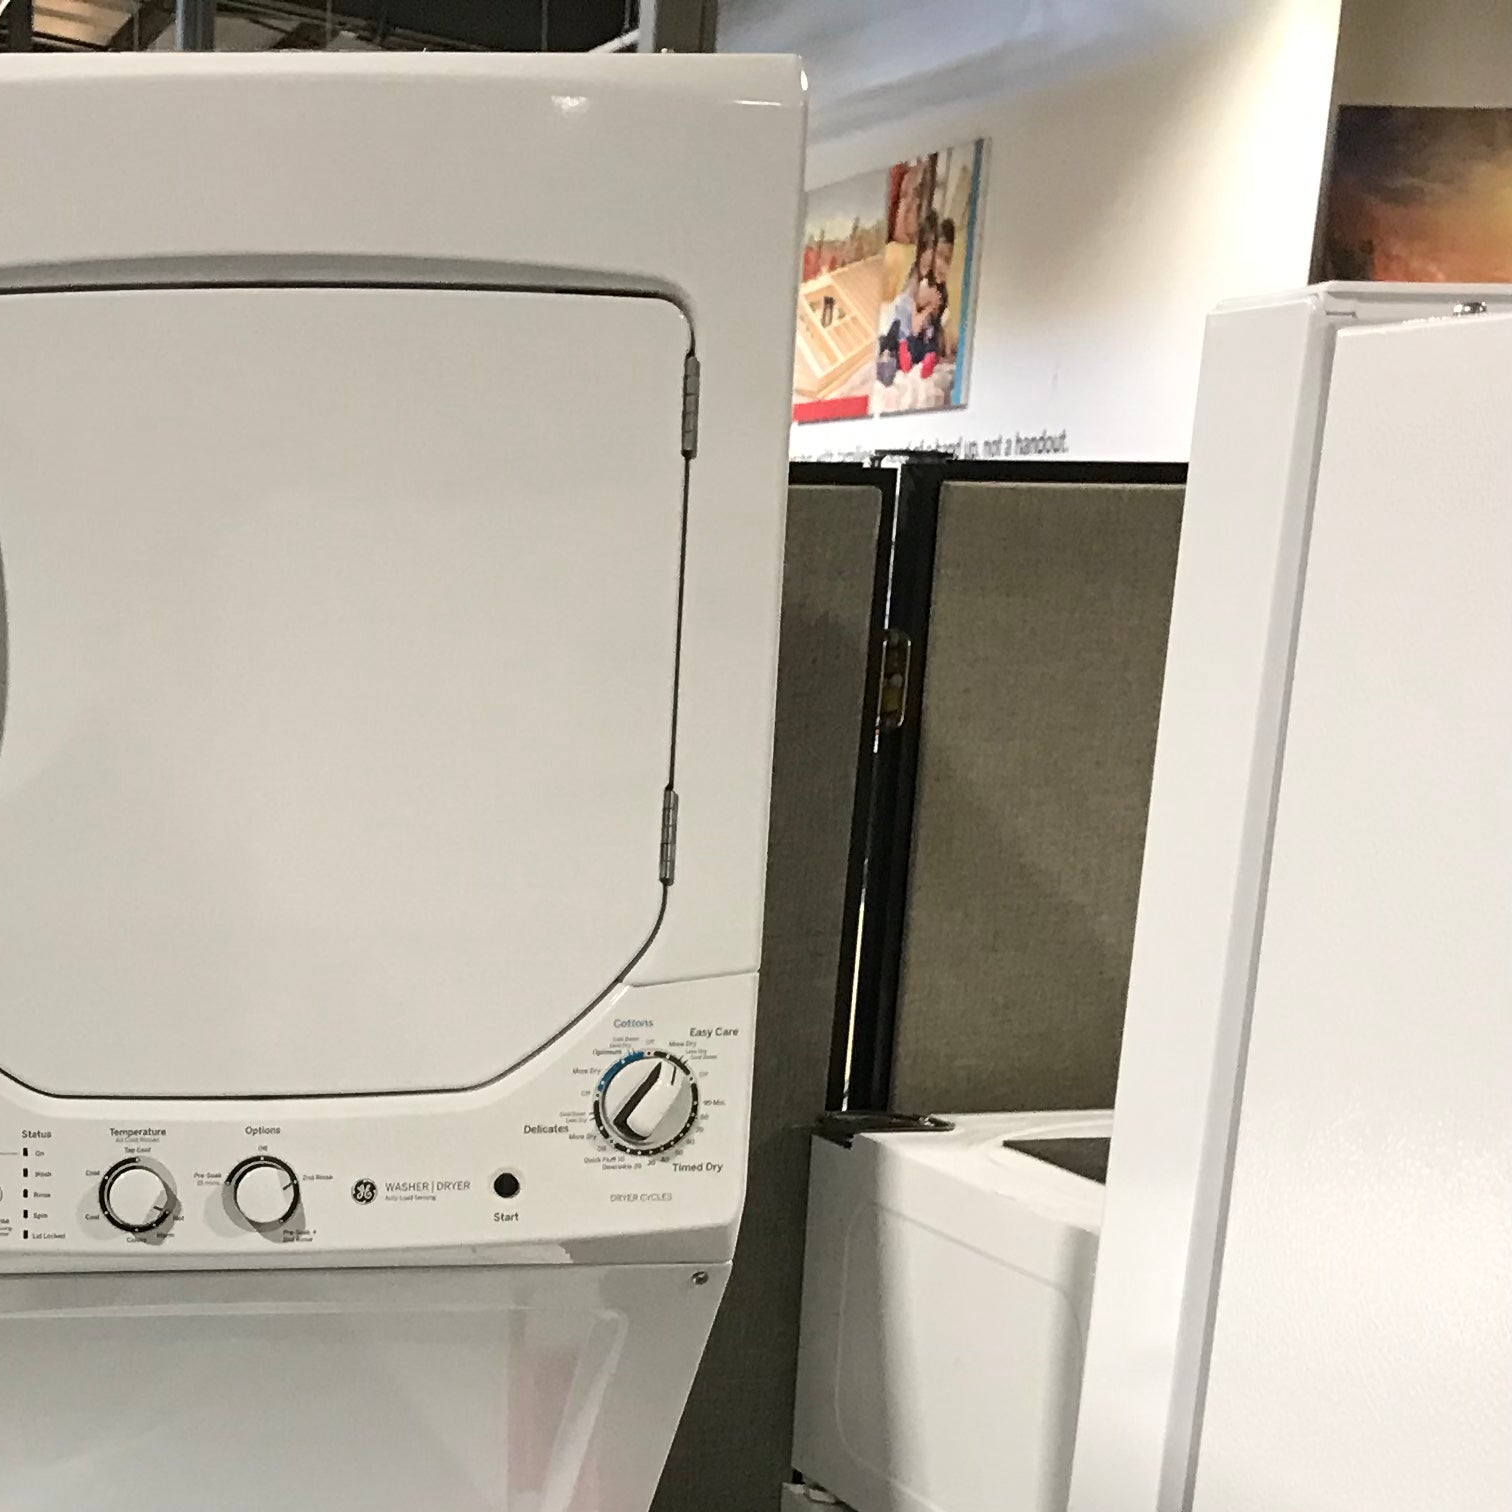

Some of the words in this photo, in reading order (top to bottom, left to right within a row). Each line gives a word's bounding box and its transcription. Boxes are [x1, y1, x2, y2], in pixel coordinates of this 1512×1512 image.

[613, 1018, 654, 1028] Cottons
[690, 1027, 713, 1038] Easy
[715, 1027, 739, 1037] Care
[21, 1129, 52, 1139] Status
[109, 1128, 167, 1138] Temperature
[245, 1126, 281, 1136] Options
[524, 1124, 569, 1134] Delicates
[672, 1163, 703, 1172] Timed
[705, 1162, 723, 1173] Dry
[385, 1181, 430, 1192] WASHER
[436, 1181, 471, 1191] DRYER
[610, 1193, 639, 1202] DRYER
[640, 1193, 673, 1201] CYCLES
[493, 1212, 520, 1222] Start
